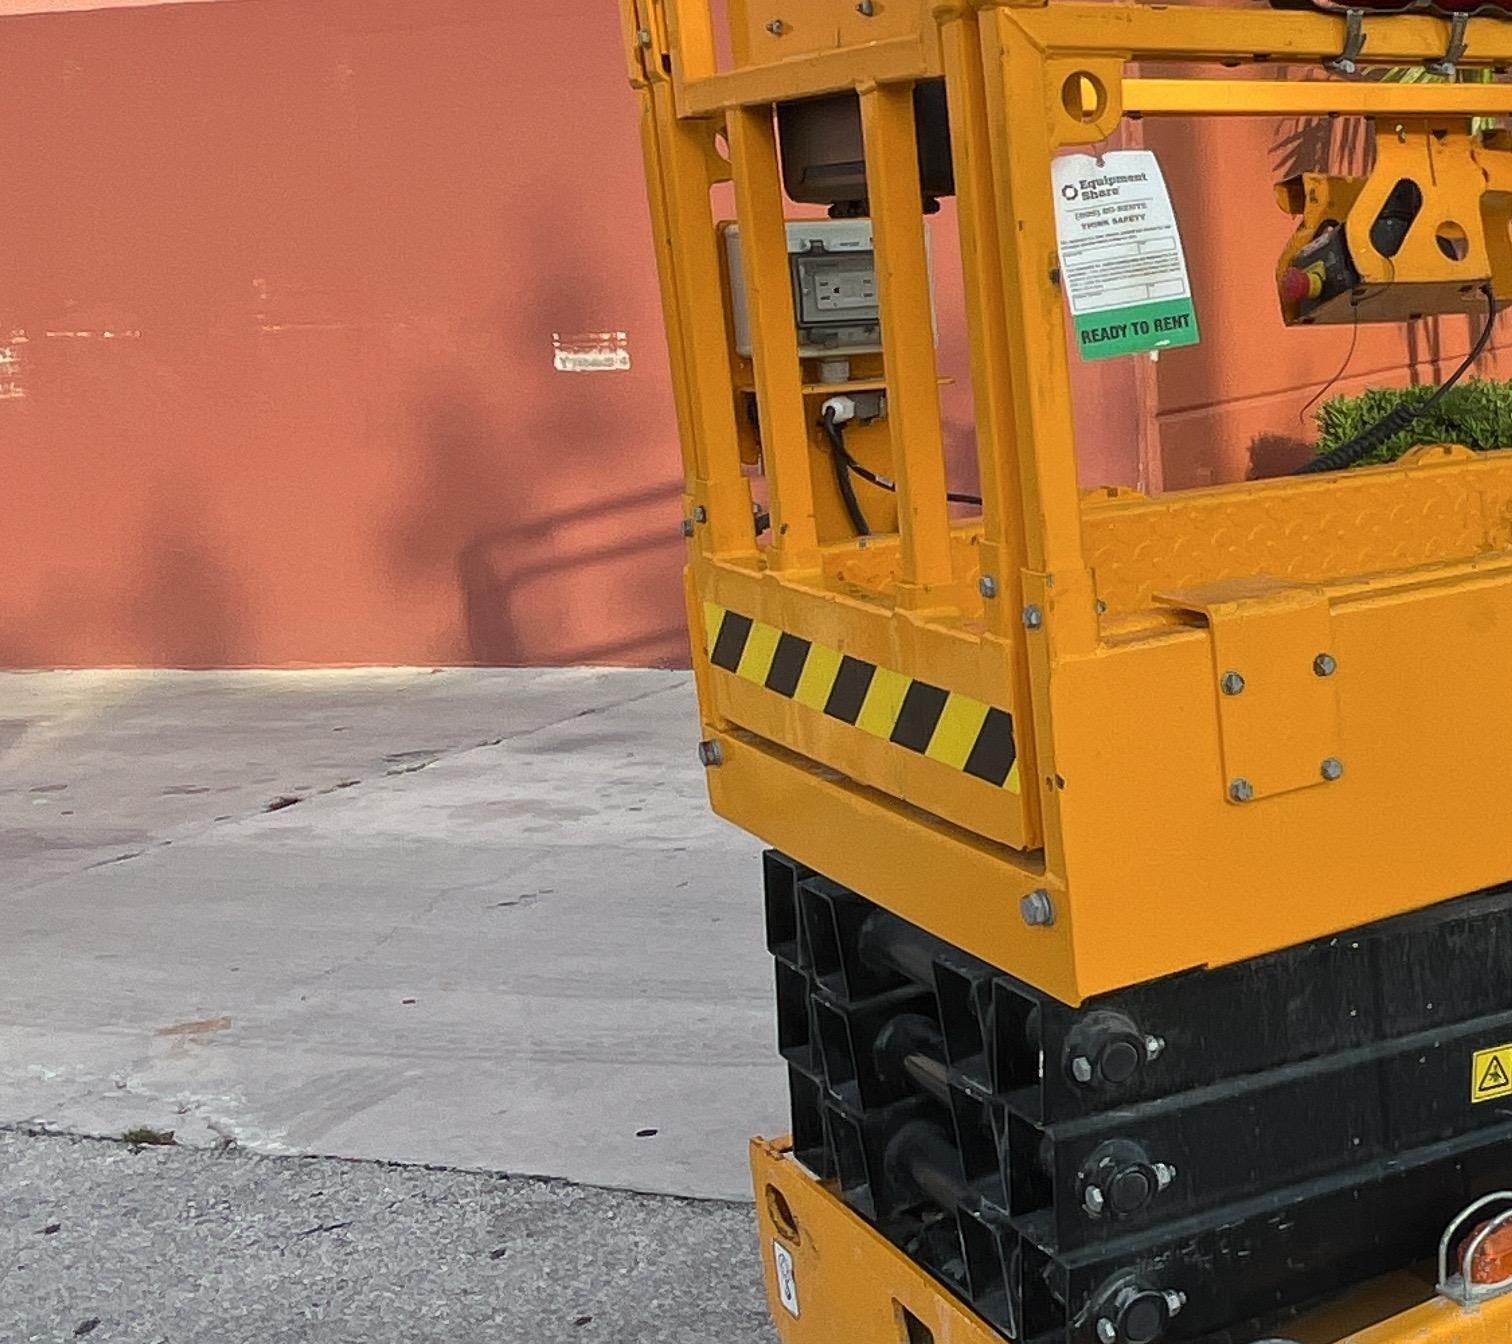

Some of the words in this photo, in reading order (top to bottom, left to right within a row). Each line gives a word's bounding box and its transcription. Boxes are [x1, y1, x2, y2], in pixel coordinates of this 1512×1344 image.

[1079, 172, 1148, 190] Equipment
[1081, 187, 1120, 201] Share
[1081, 324, 1128, 345] READY
[1132, 319, 1150, 336] TO
[1154, 313, 1190, 333] RENT
